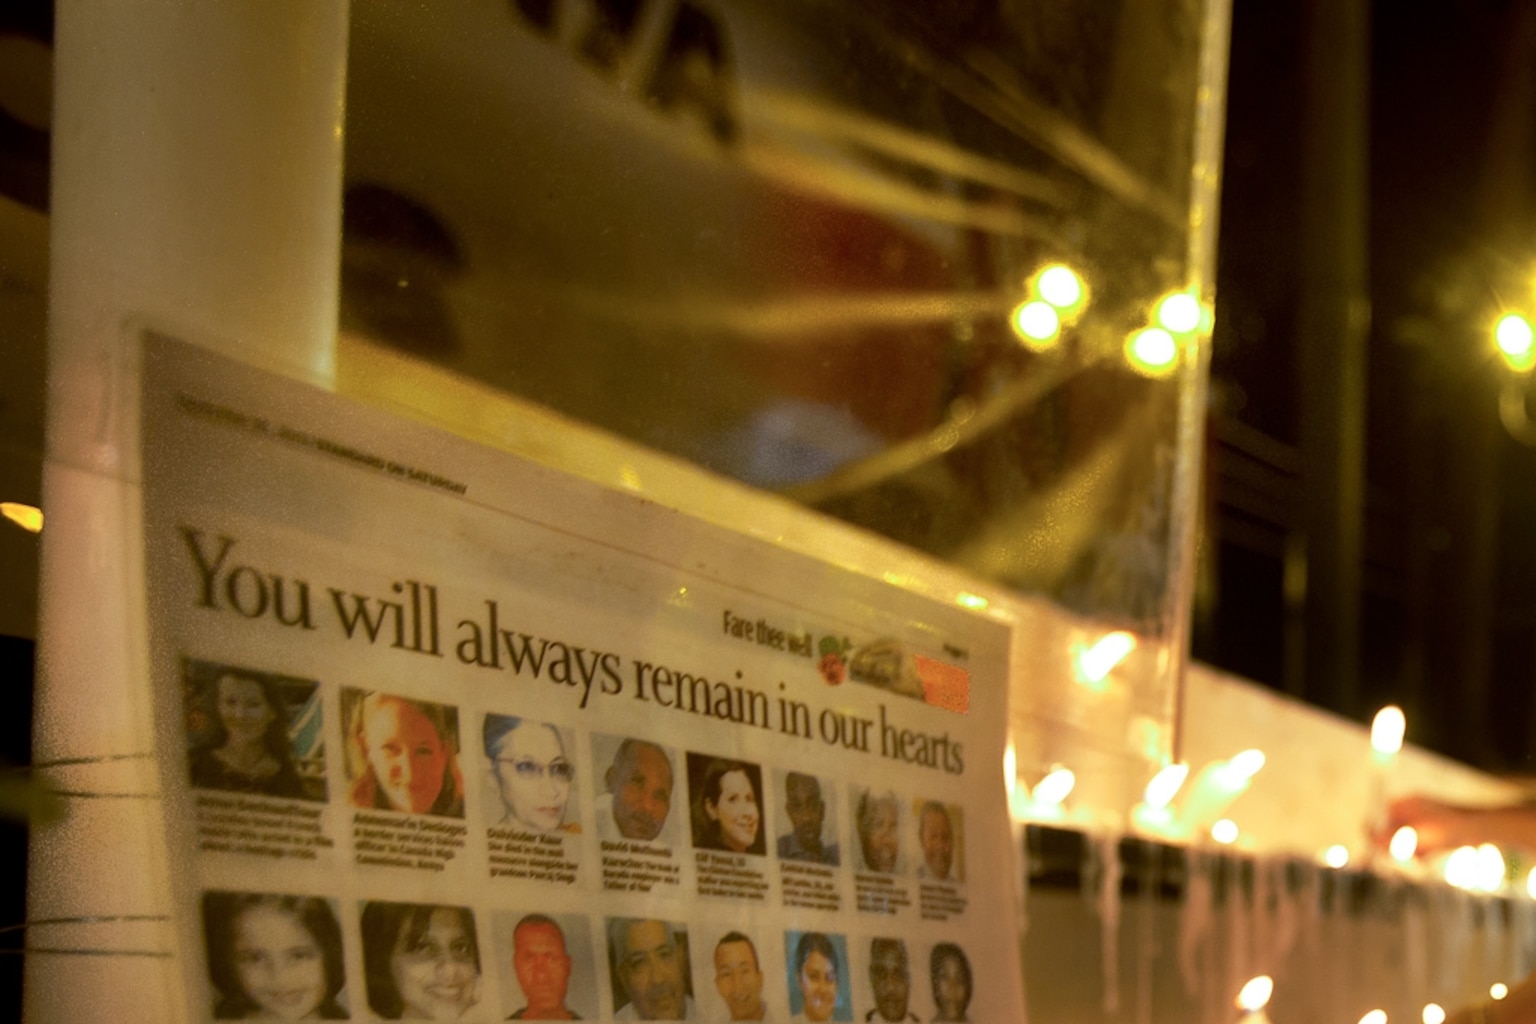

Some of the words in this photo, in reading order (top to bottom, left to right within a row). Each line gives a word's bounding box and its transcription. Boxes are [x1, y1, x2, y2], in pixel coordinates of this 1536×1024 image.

[406, 466, 468, 496] SATURDAY
[176, 521, 318, 631] You
[326, 579, 444, 658] will
[455, 599, 623, 710] always
[632, 657, 771, 738] remain
[777, 681, 813, 741] in
[819, 707, 874, 755] our
[878, 703, 966, 776] hearts
[722, 609, 754, 642] Fare
[755, 621, 785, 652] thee
[786, 633, 814, 659] well
